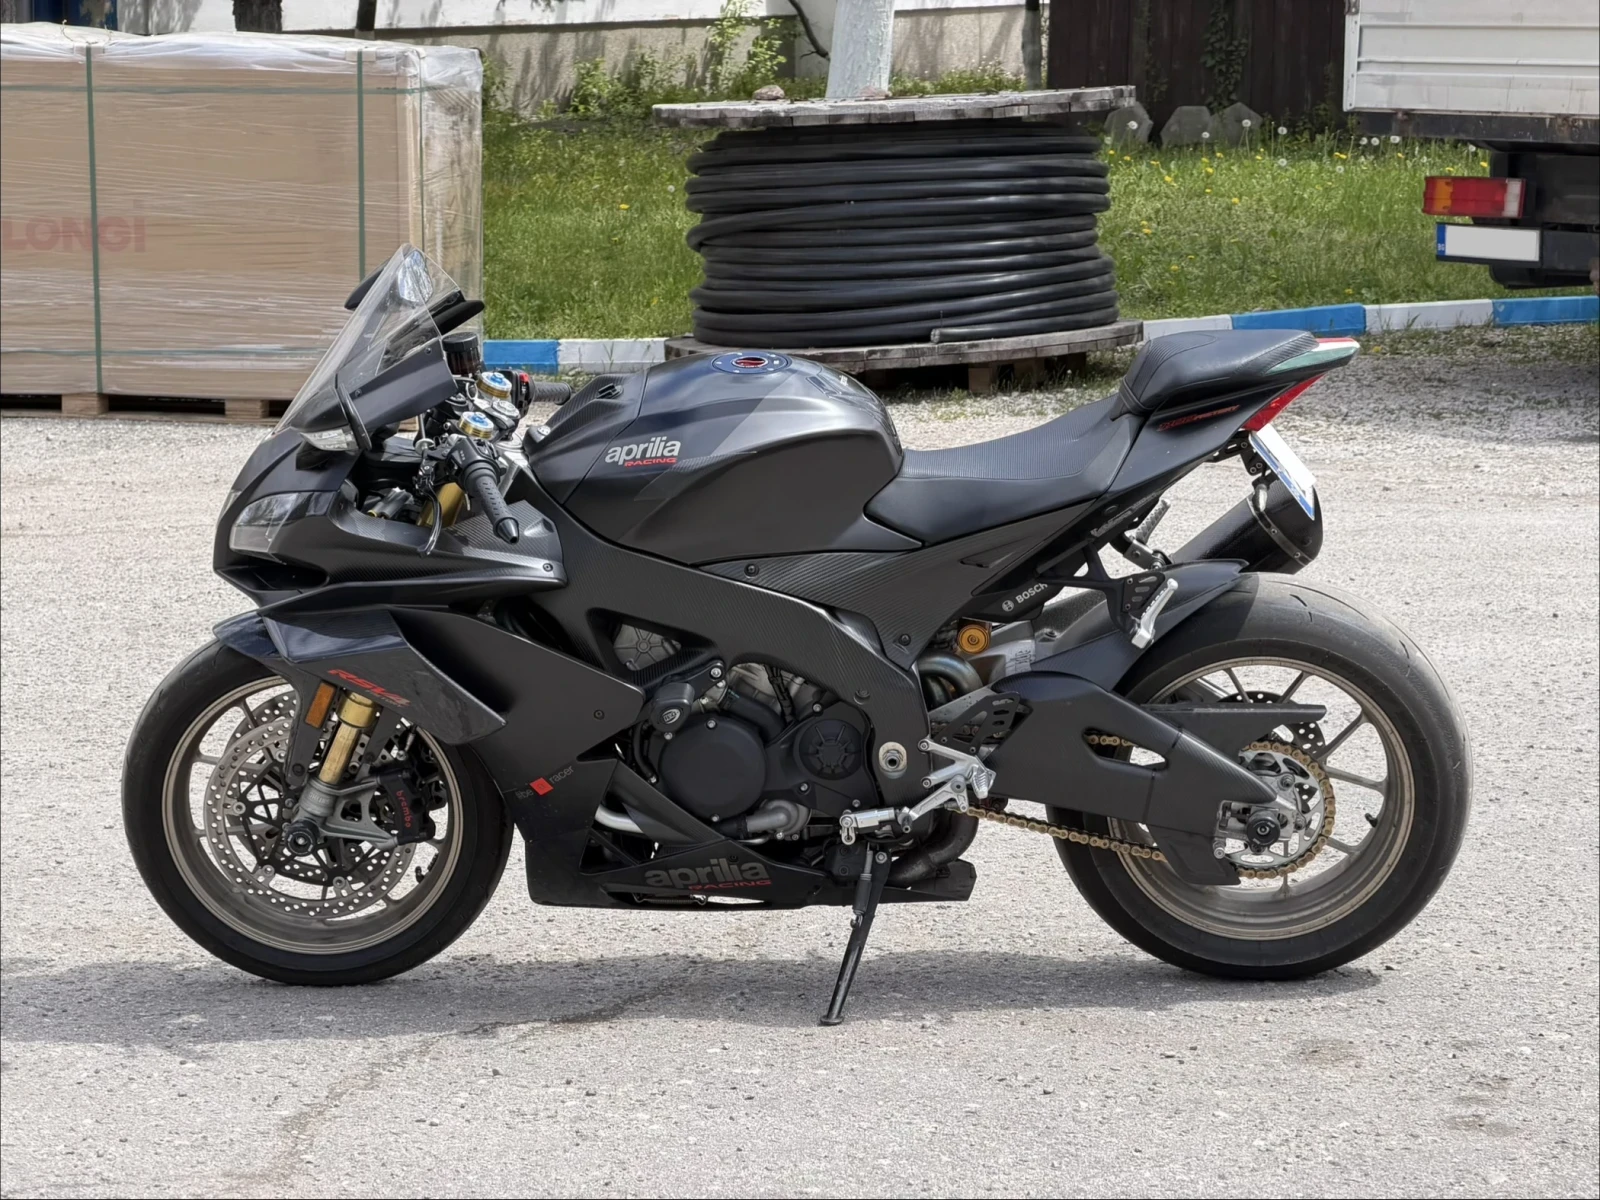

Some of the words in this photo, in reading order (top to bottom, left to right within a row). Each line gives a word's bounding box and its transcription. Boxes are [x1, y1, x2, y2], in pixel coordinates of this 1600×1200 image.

[605, 436, 681, 466] aprilia
[624, 457, 678, 467] RACING
[1015, 583, 1048, 604] BOSCH
[549, 765, 574, 784] racer
[396, 790, 413, 828] brembo
[644, 858, 770, 889] aprilia
[688, 880, 772, 891] RACING
